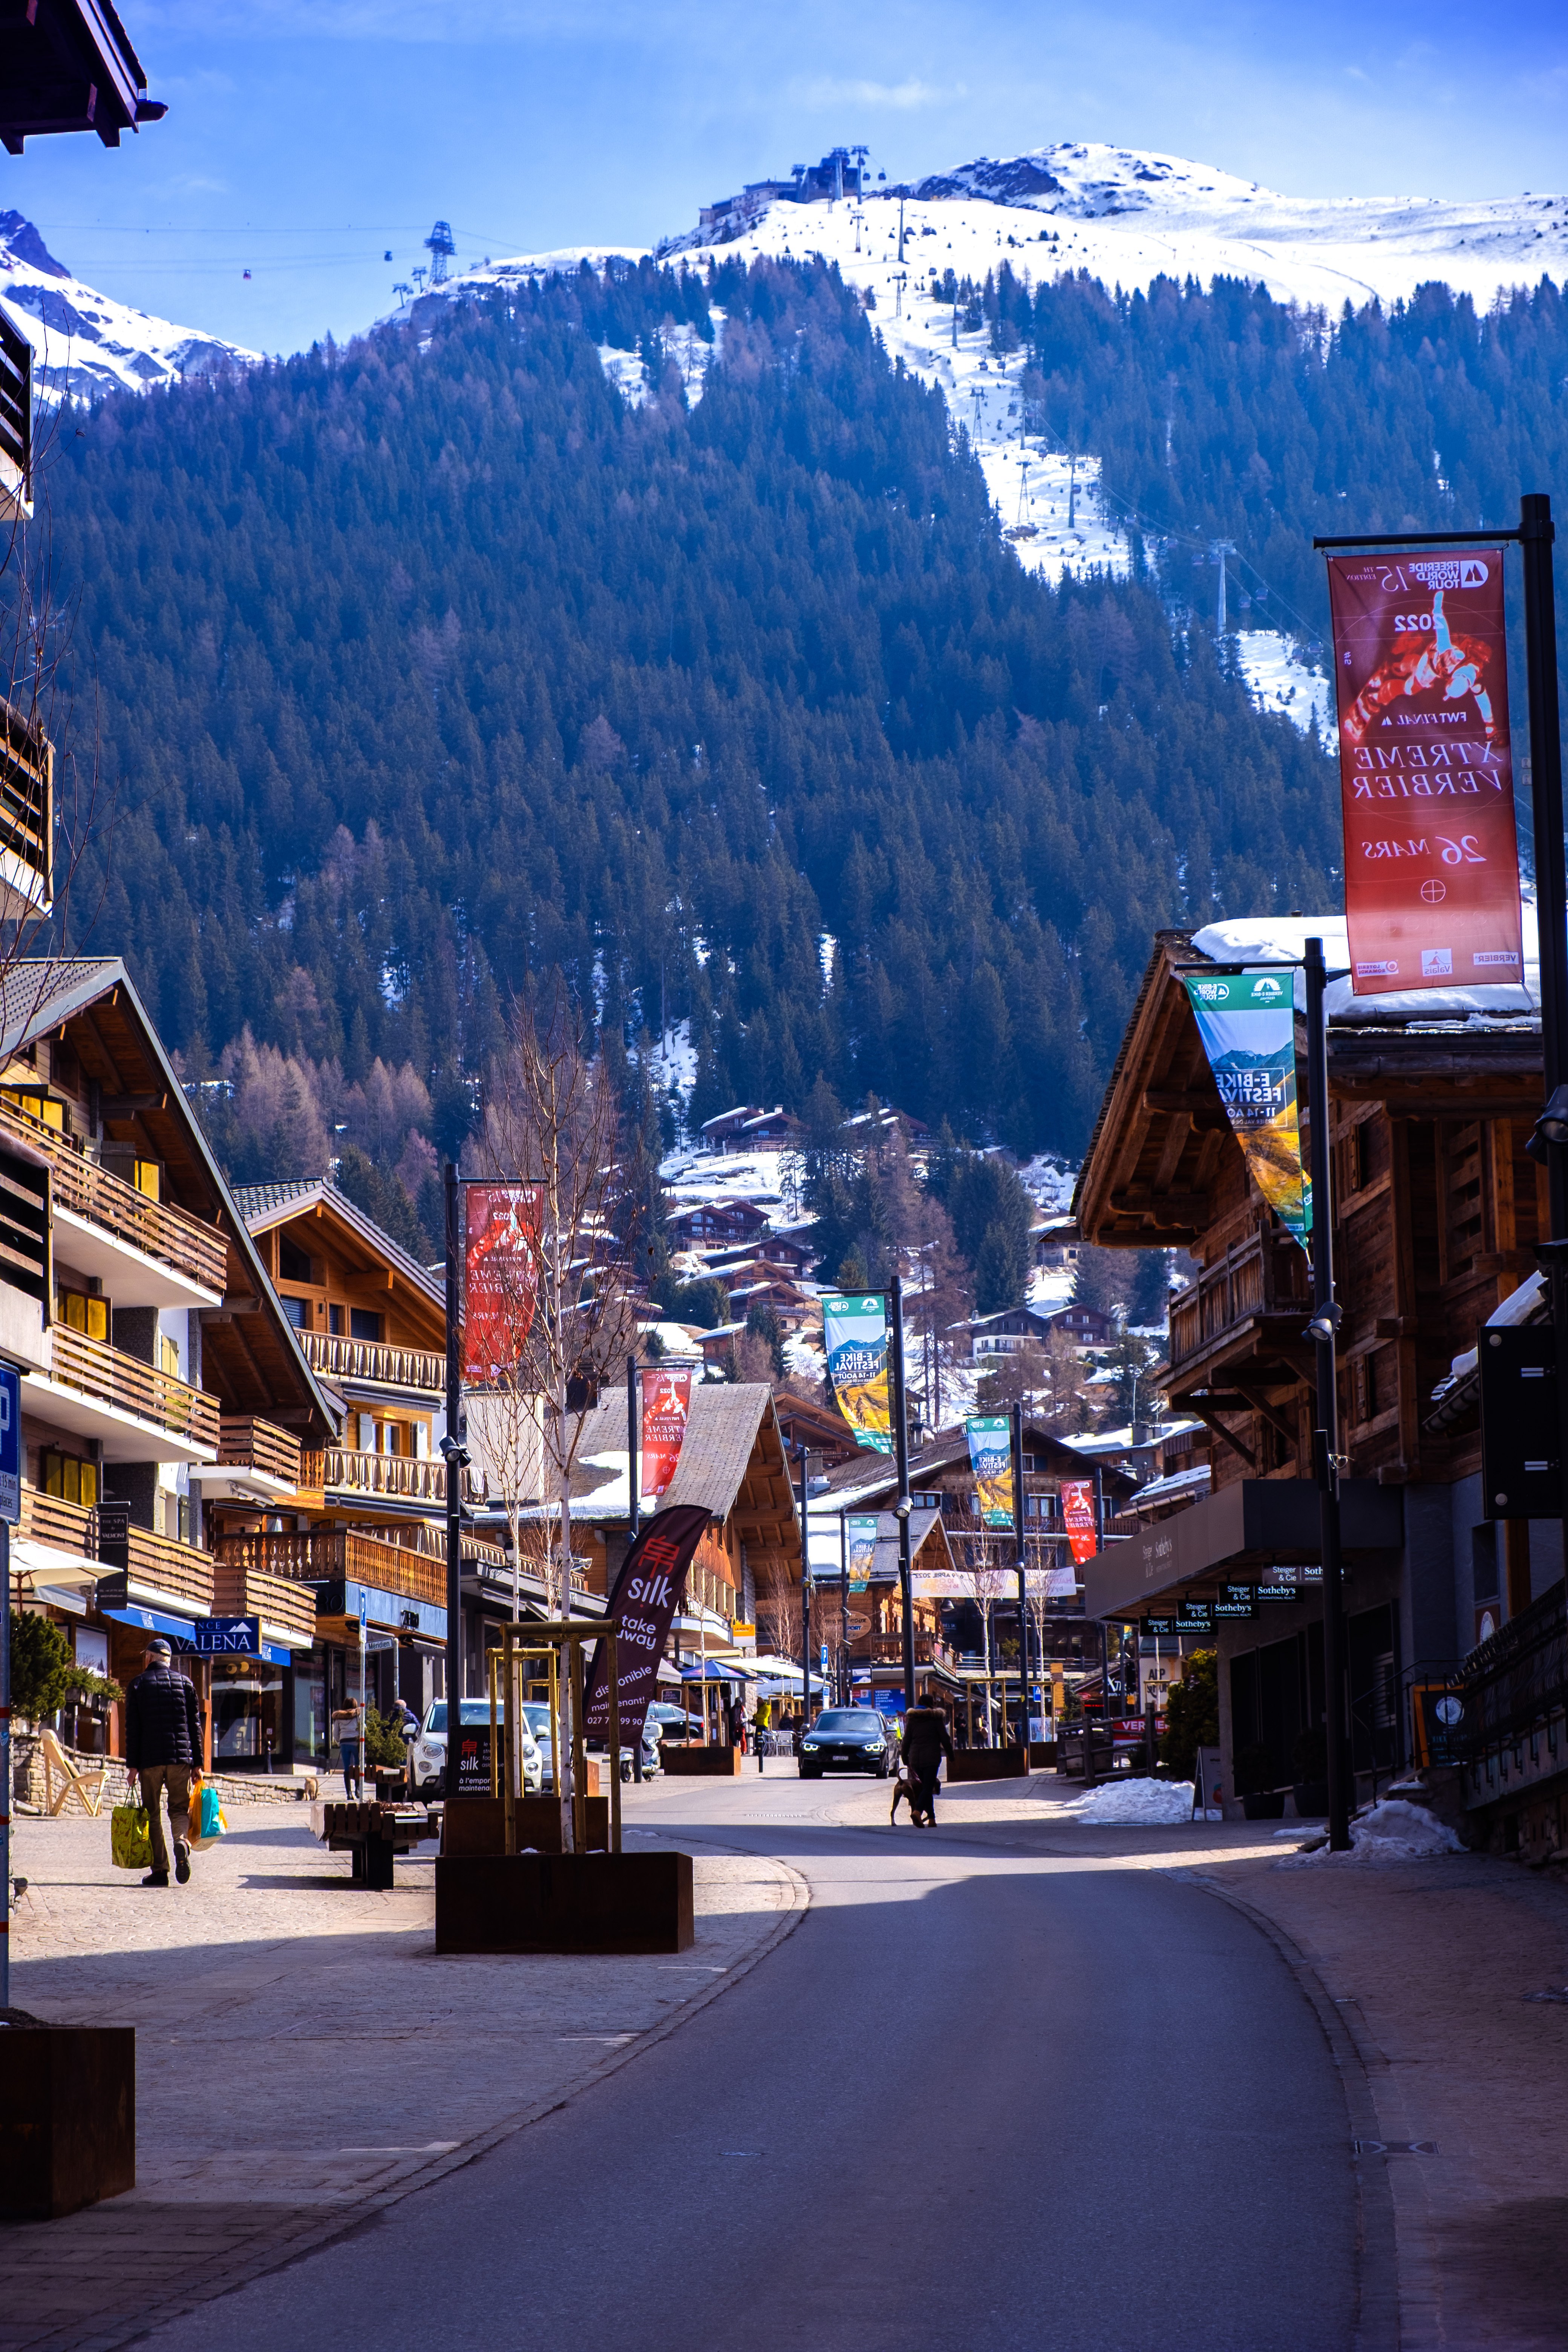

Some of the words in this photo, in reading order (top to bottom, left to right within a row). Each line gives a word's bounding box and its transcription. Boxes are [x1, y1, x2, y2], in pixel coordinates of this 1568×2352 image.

[2, 1474, 7, 1488] 15
[1272, 1566, 1296, 1574] Steiger
[627, 1575, 673, 1608] silk
[1258, 1586, 1296, 1596] Sotheby's
[362, 1597, 364, 1620] P
[1215, 1603, 1251, 1612] Sotheby's
[622, 1615, 656, 1634] take
[174, 1634, 251, 1651] VALENA
[368, 1641, 390, 1650] Méridien
[823, 1649, 827, 1662] P
[595, 1666, 652, 1698] disonible
[591, 1696, 645, 1712] maienant!
[1122, 1720, 1170, 1731] VERIE
[460, 1756, 479, 1770] silk
